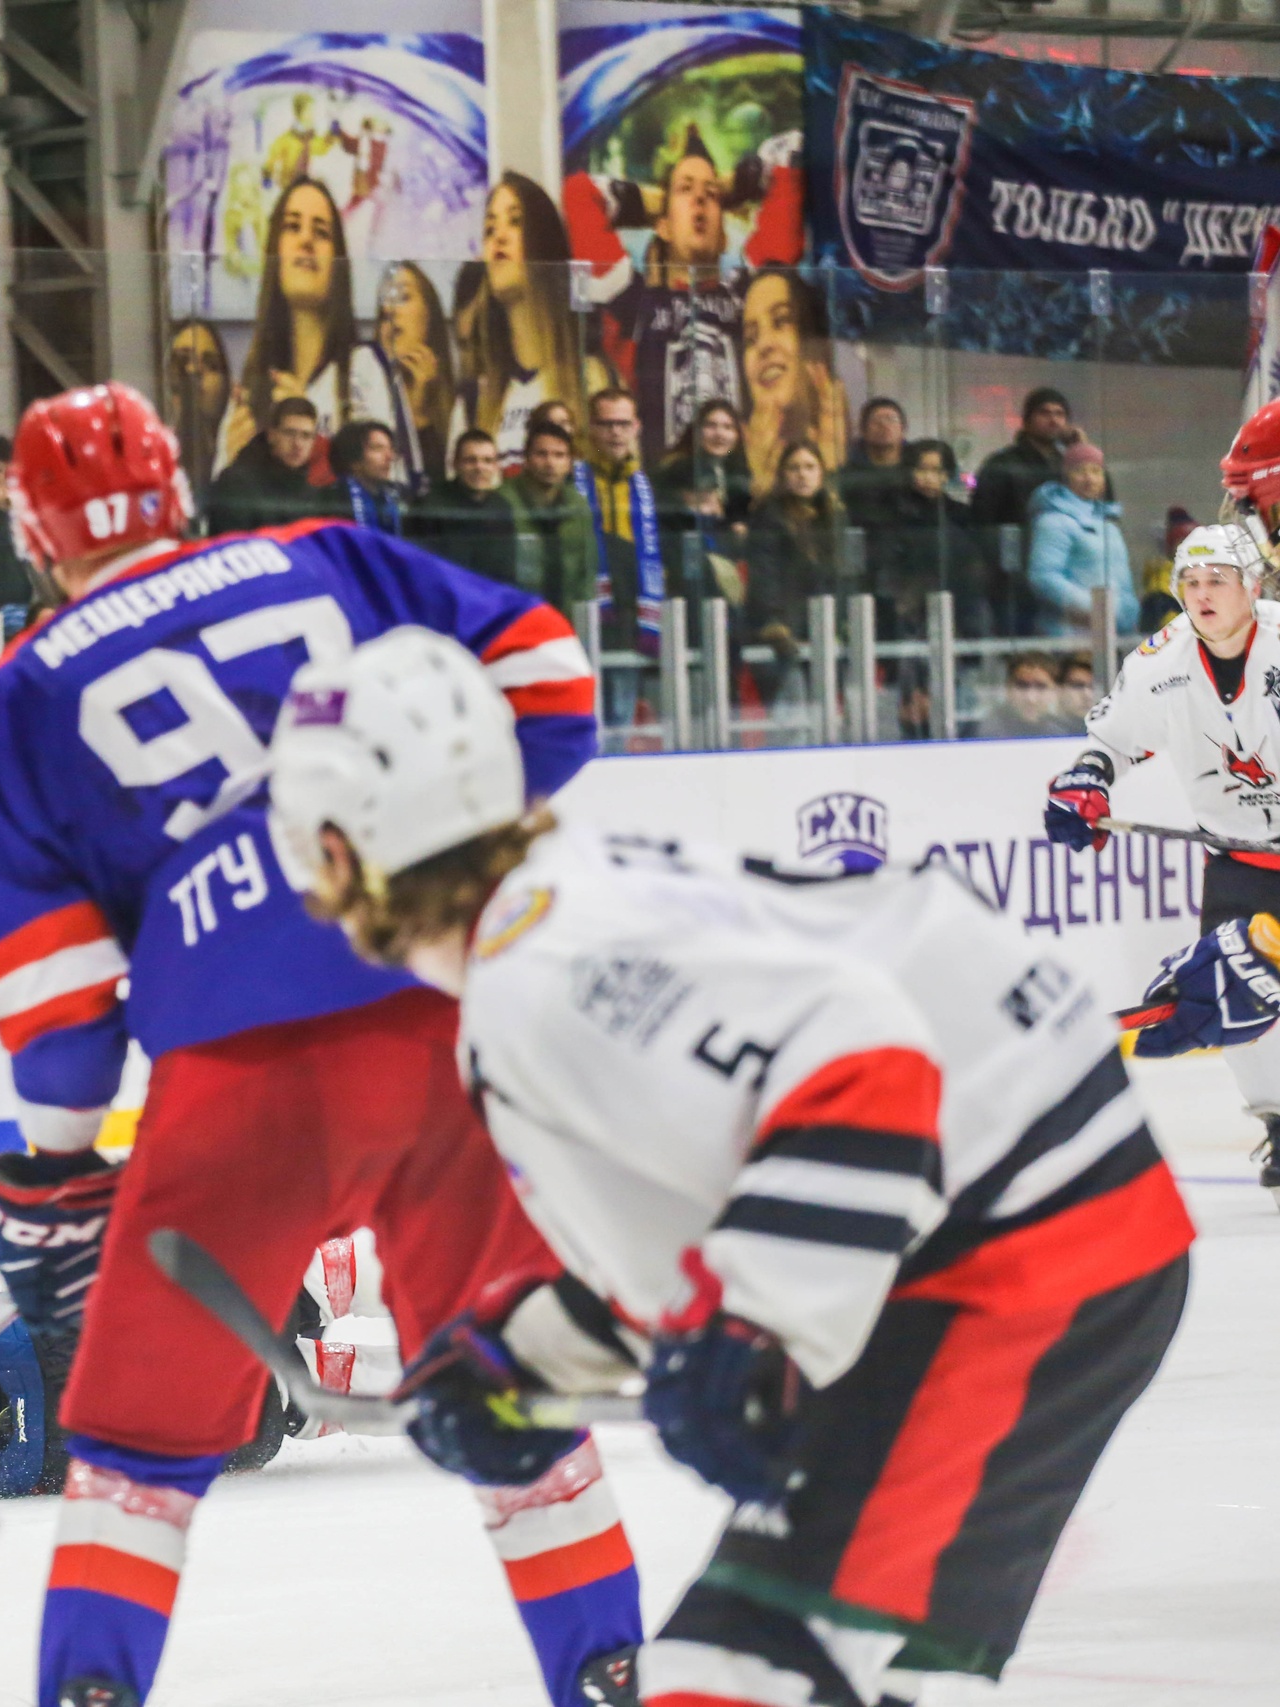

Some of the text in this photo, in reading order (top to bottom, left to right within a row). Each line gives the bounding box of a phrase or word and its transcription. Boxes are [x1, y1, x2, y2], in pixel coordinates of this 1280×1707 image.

[989, 178, 1157, 251] ТОЛЬКО
[33, 538, 292, 669] МЕЩЕРЯКОВ
[167, 832, 269, 947] ТГУ
